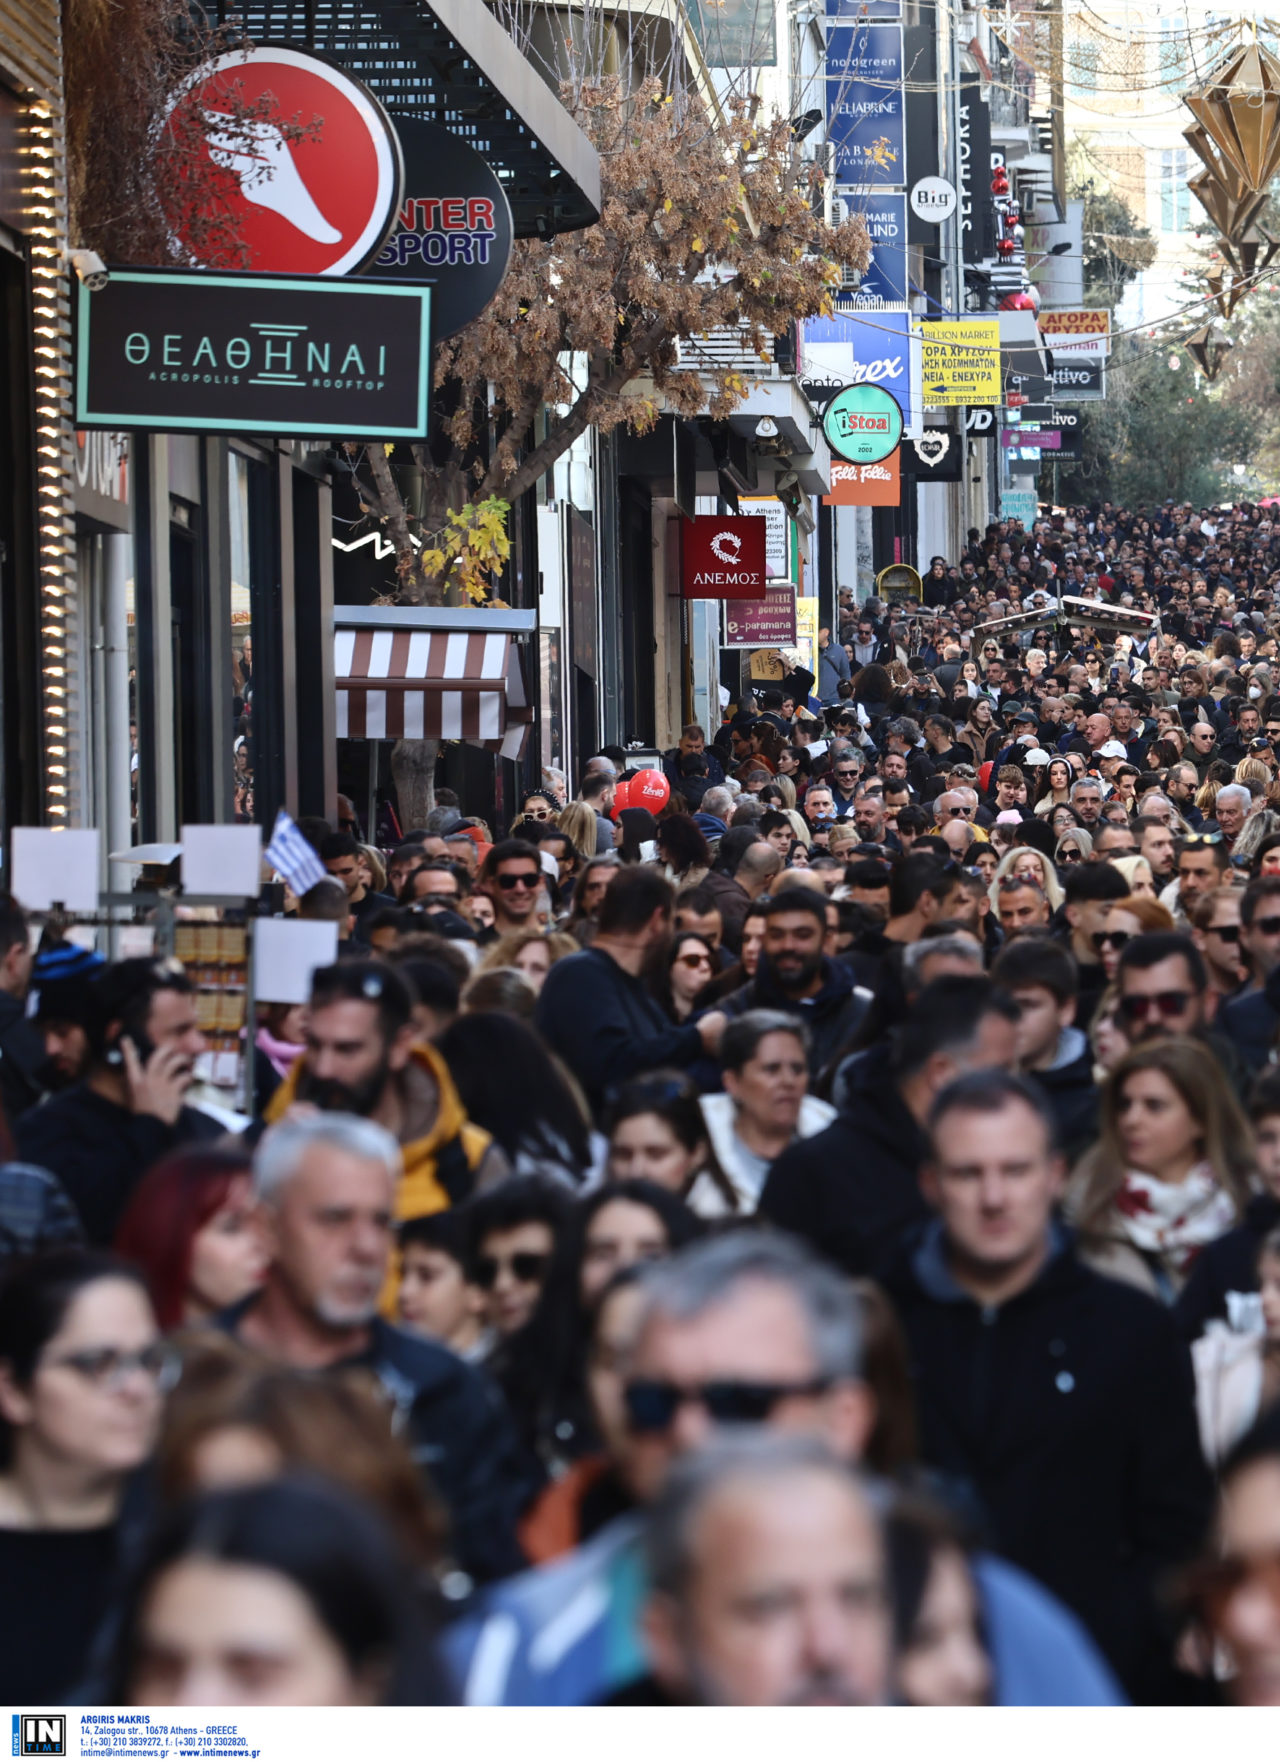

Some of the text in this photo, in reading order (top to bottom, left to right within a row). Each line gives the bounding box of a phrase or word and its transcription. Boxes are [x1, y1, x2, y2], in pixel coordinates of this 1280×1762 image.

[918, 190, 948, 206] Big
[375, 231, 497, 266] SPORT
[1046, 313, 1101, 324] ΑΓΟΡΑ
[960, 331, 995, 339] MARKET
[942, 359, 995, 368] ΚΟΣΜΗΜΑΤΩΝ
[149, 371, 385, 391] ACROPOLIS ROOFTOP
[922, 372, 944, 382] ΝΕΙΑ
[952, 371, 992, 382] ΕΝΕΧΥΡΑ
[841, 415, 888, 430] iStoa
[831, 464, 892, 487] Folli Follie
[693, 573, 760, 584] ΑΝΕΜΟΣ
[727, 621, 792, 634] e-paramana
